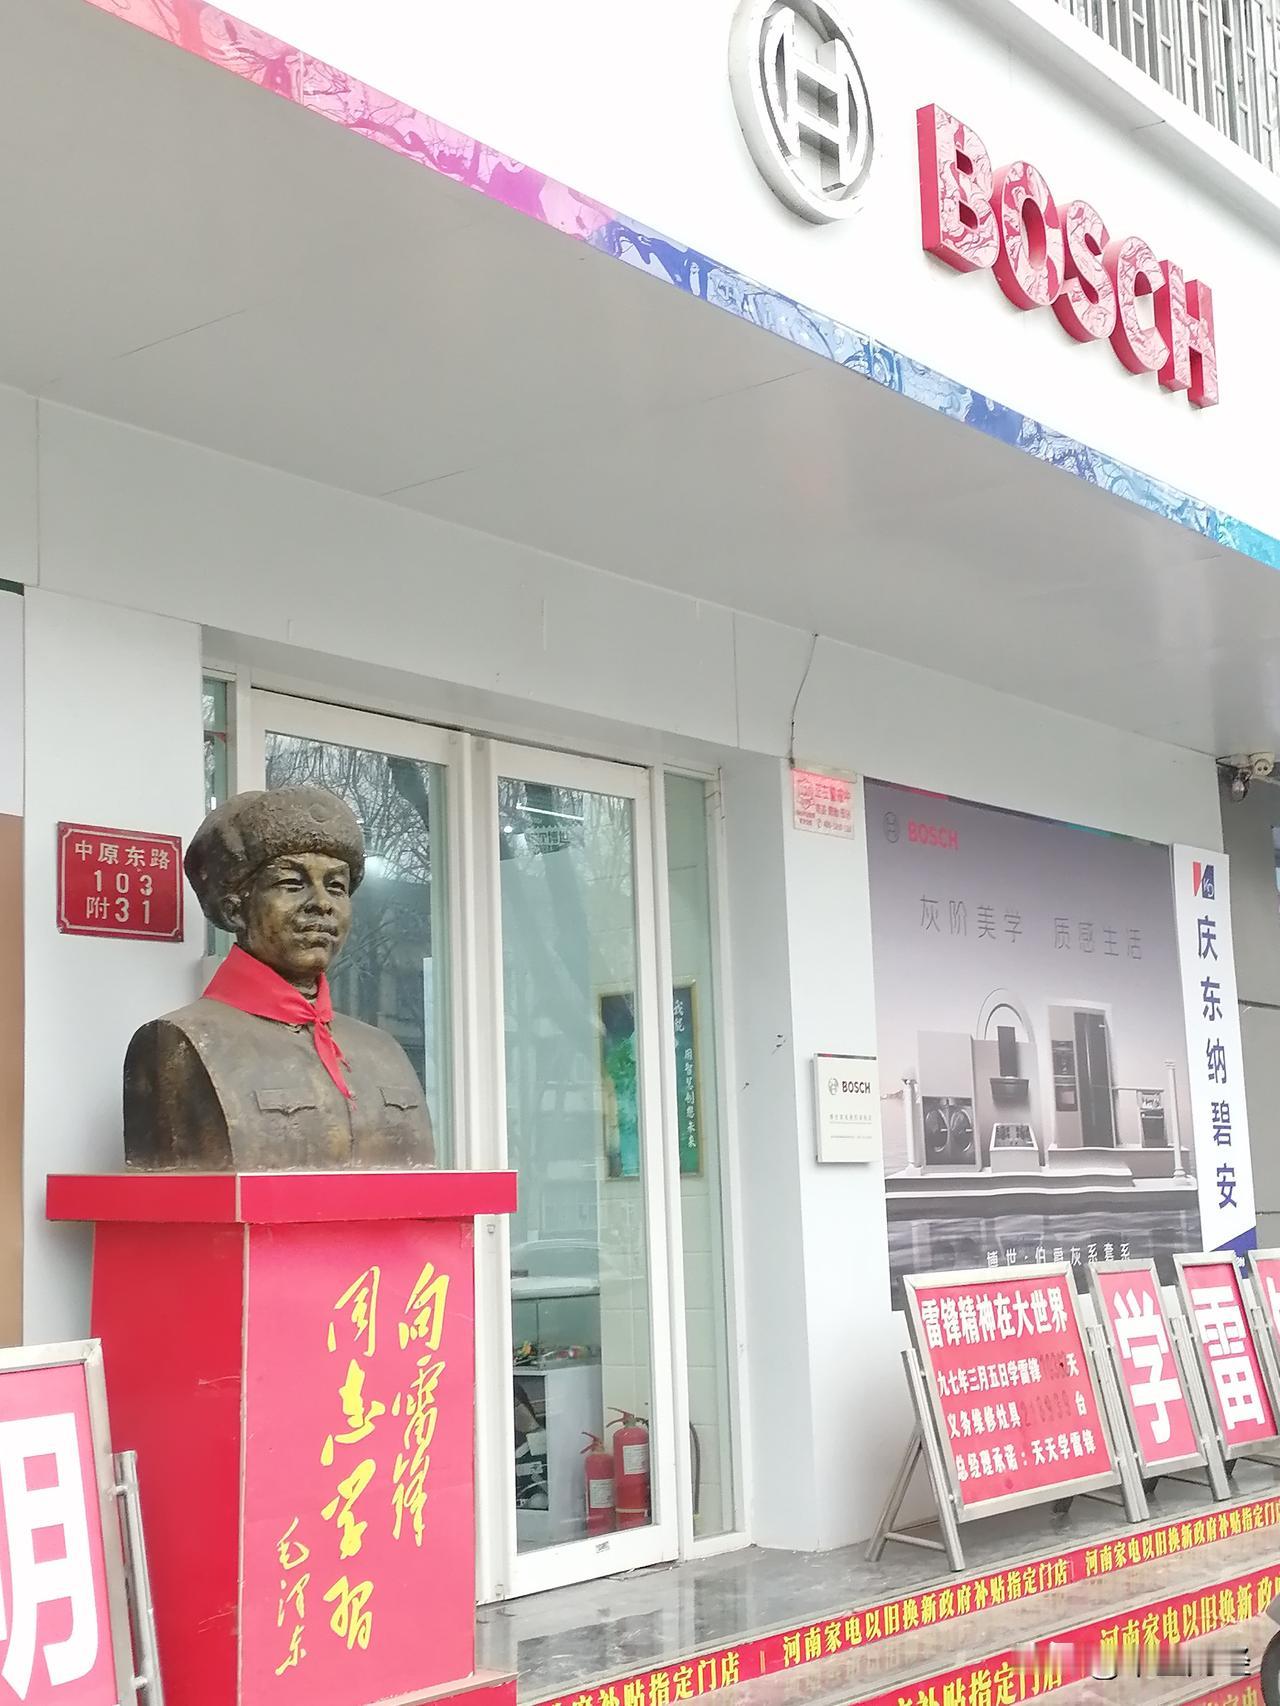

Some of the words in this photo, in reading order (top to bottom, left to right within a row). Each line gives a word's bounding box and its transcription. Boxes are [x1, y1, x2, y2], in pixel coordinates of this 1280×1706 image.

[916, 103, 1218, 408] BOSCH
[75, 839, 170, 870] 中原东路
[907, 820, 959, 849] BOSCH
[86, 897, 150, 924] 附31
[94, 870, 153, 896] 103
[920, 895, 1022, 943] 灰阶美学
[1053, 917, 1142, 960] 质感生活
[842, 1081, 870, 1094] BOSCH
[1197, 915, 1237, 1209] 庆东纳碧安
[921, 1286, 1068, 1349] 雷锋精神在大世界
[1114, 1288, 1182, 1444] 学
[1191, 1286, 1265, 1430] 雷
[783, 1558, 1068, 1668] 河南家电以旧换新政府补贴指定门店
